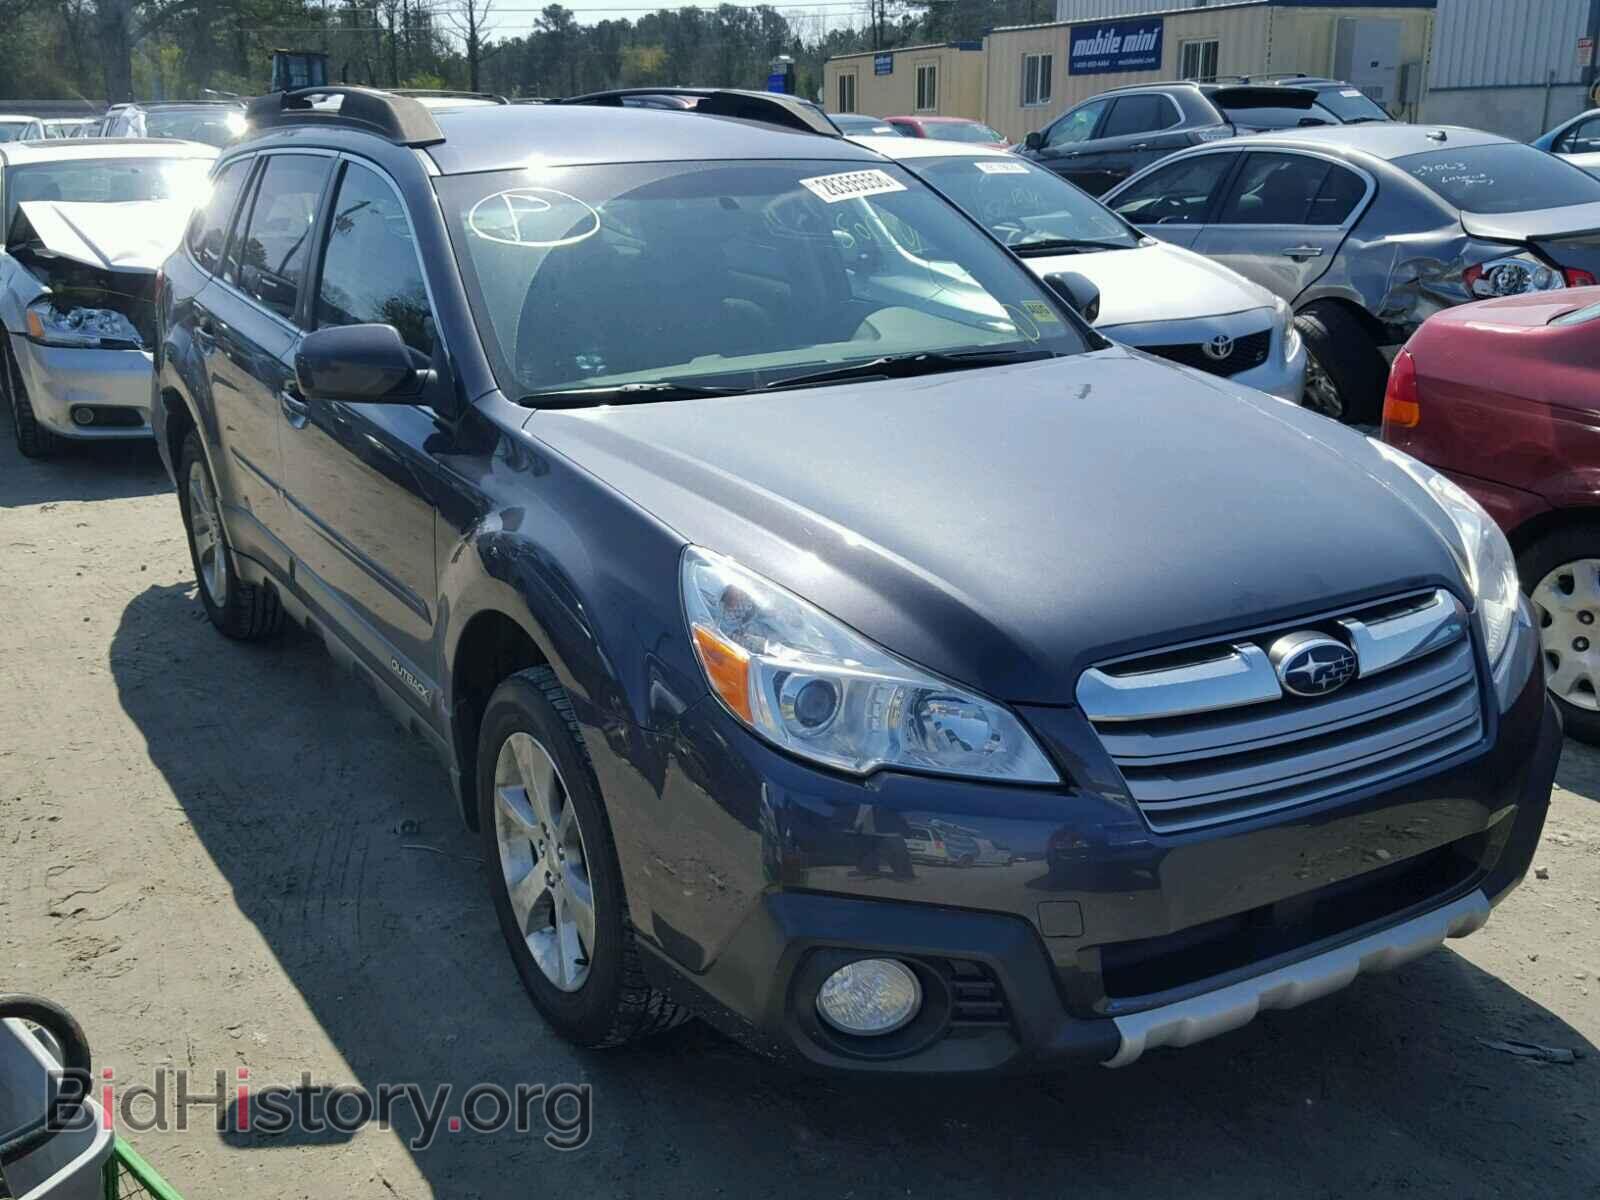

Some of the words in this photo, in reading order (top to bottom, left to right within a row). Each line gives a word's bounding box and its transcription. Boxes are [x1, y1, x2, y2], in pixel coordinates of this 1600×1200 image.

[1072, 28, 1122, 56] mobile
[1121, 27, 1159, 53] mini
[391, 659, 432, 706] OUTBACK
